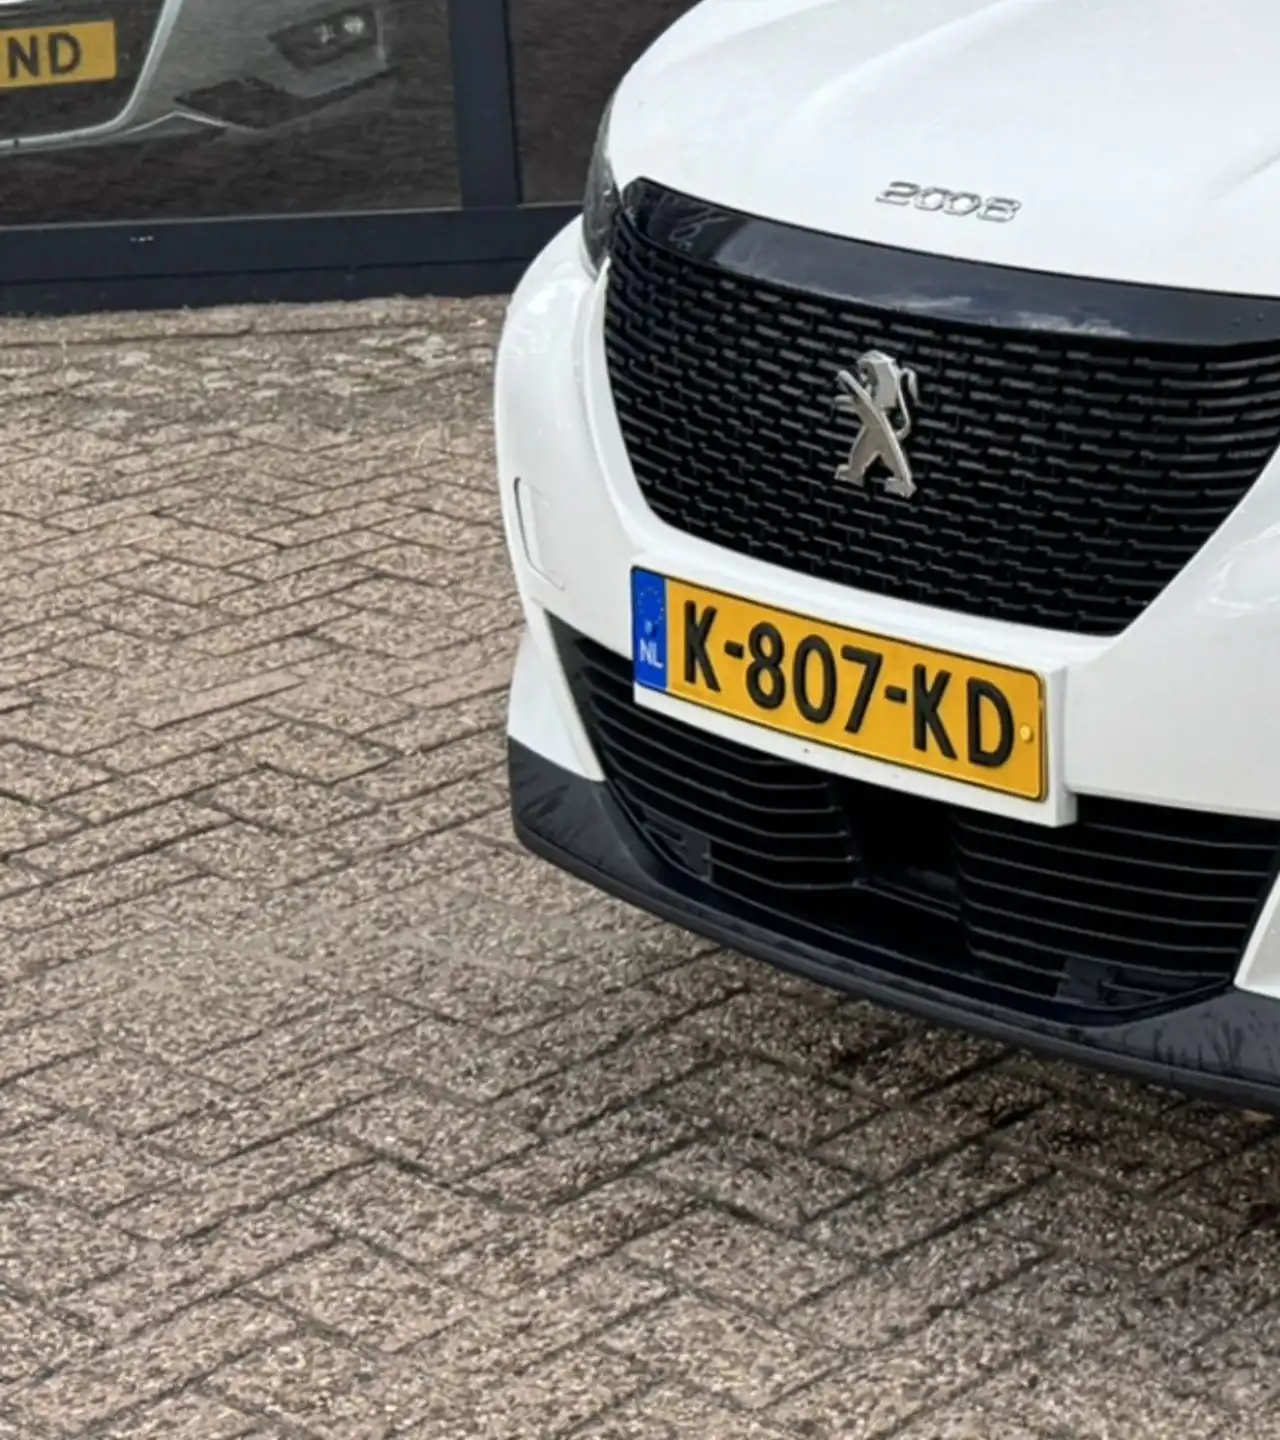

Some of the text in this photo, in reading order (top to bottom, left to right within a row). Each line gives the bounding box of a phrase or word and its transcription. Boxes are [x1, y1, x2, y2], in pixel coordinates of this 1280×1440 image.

[7, 32, 82, 78] ND
[875, 181, 1023, 223] 2008
[639, 638, 664, 669] NL
[684, 599, 1014, 768] K-807-KD
